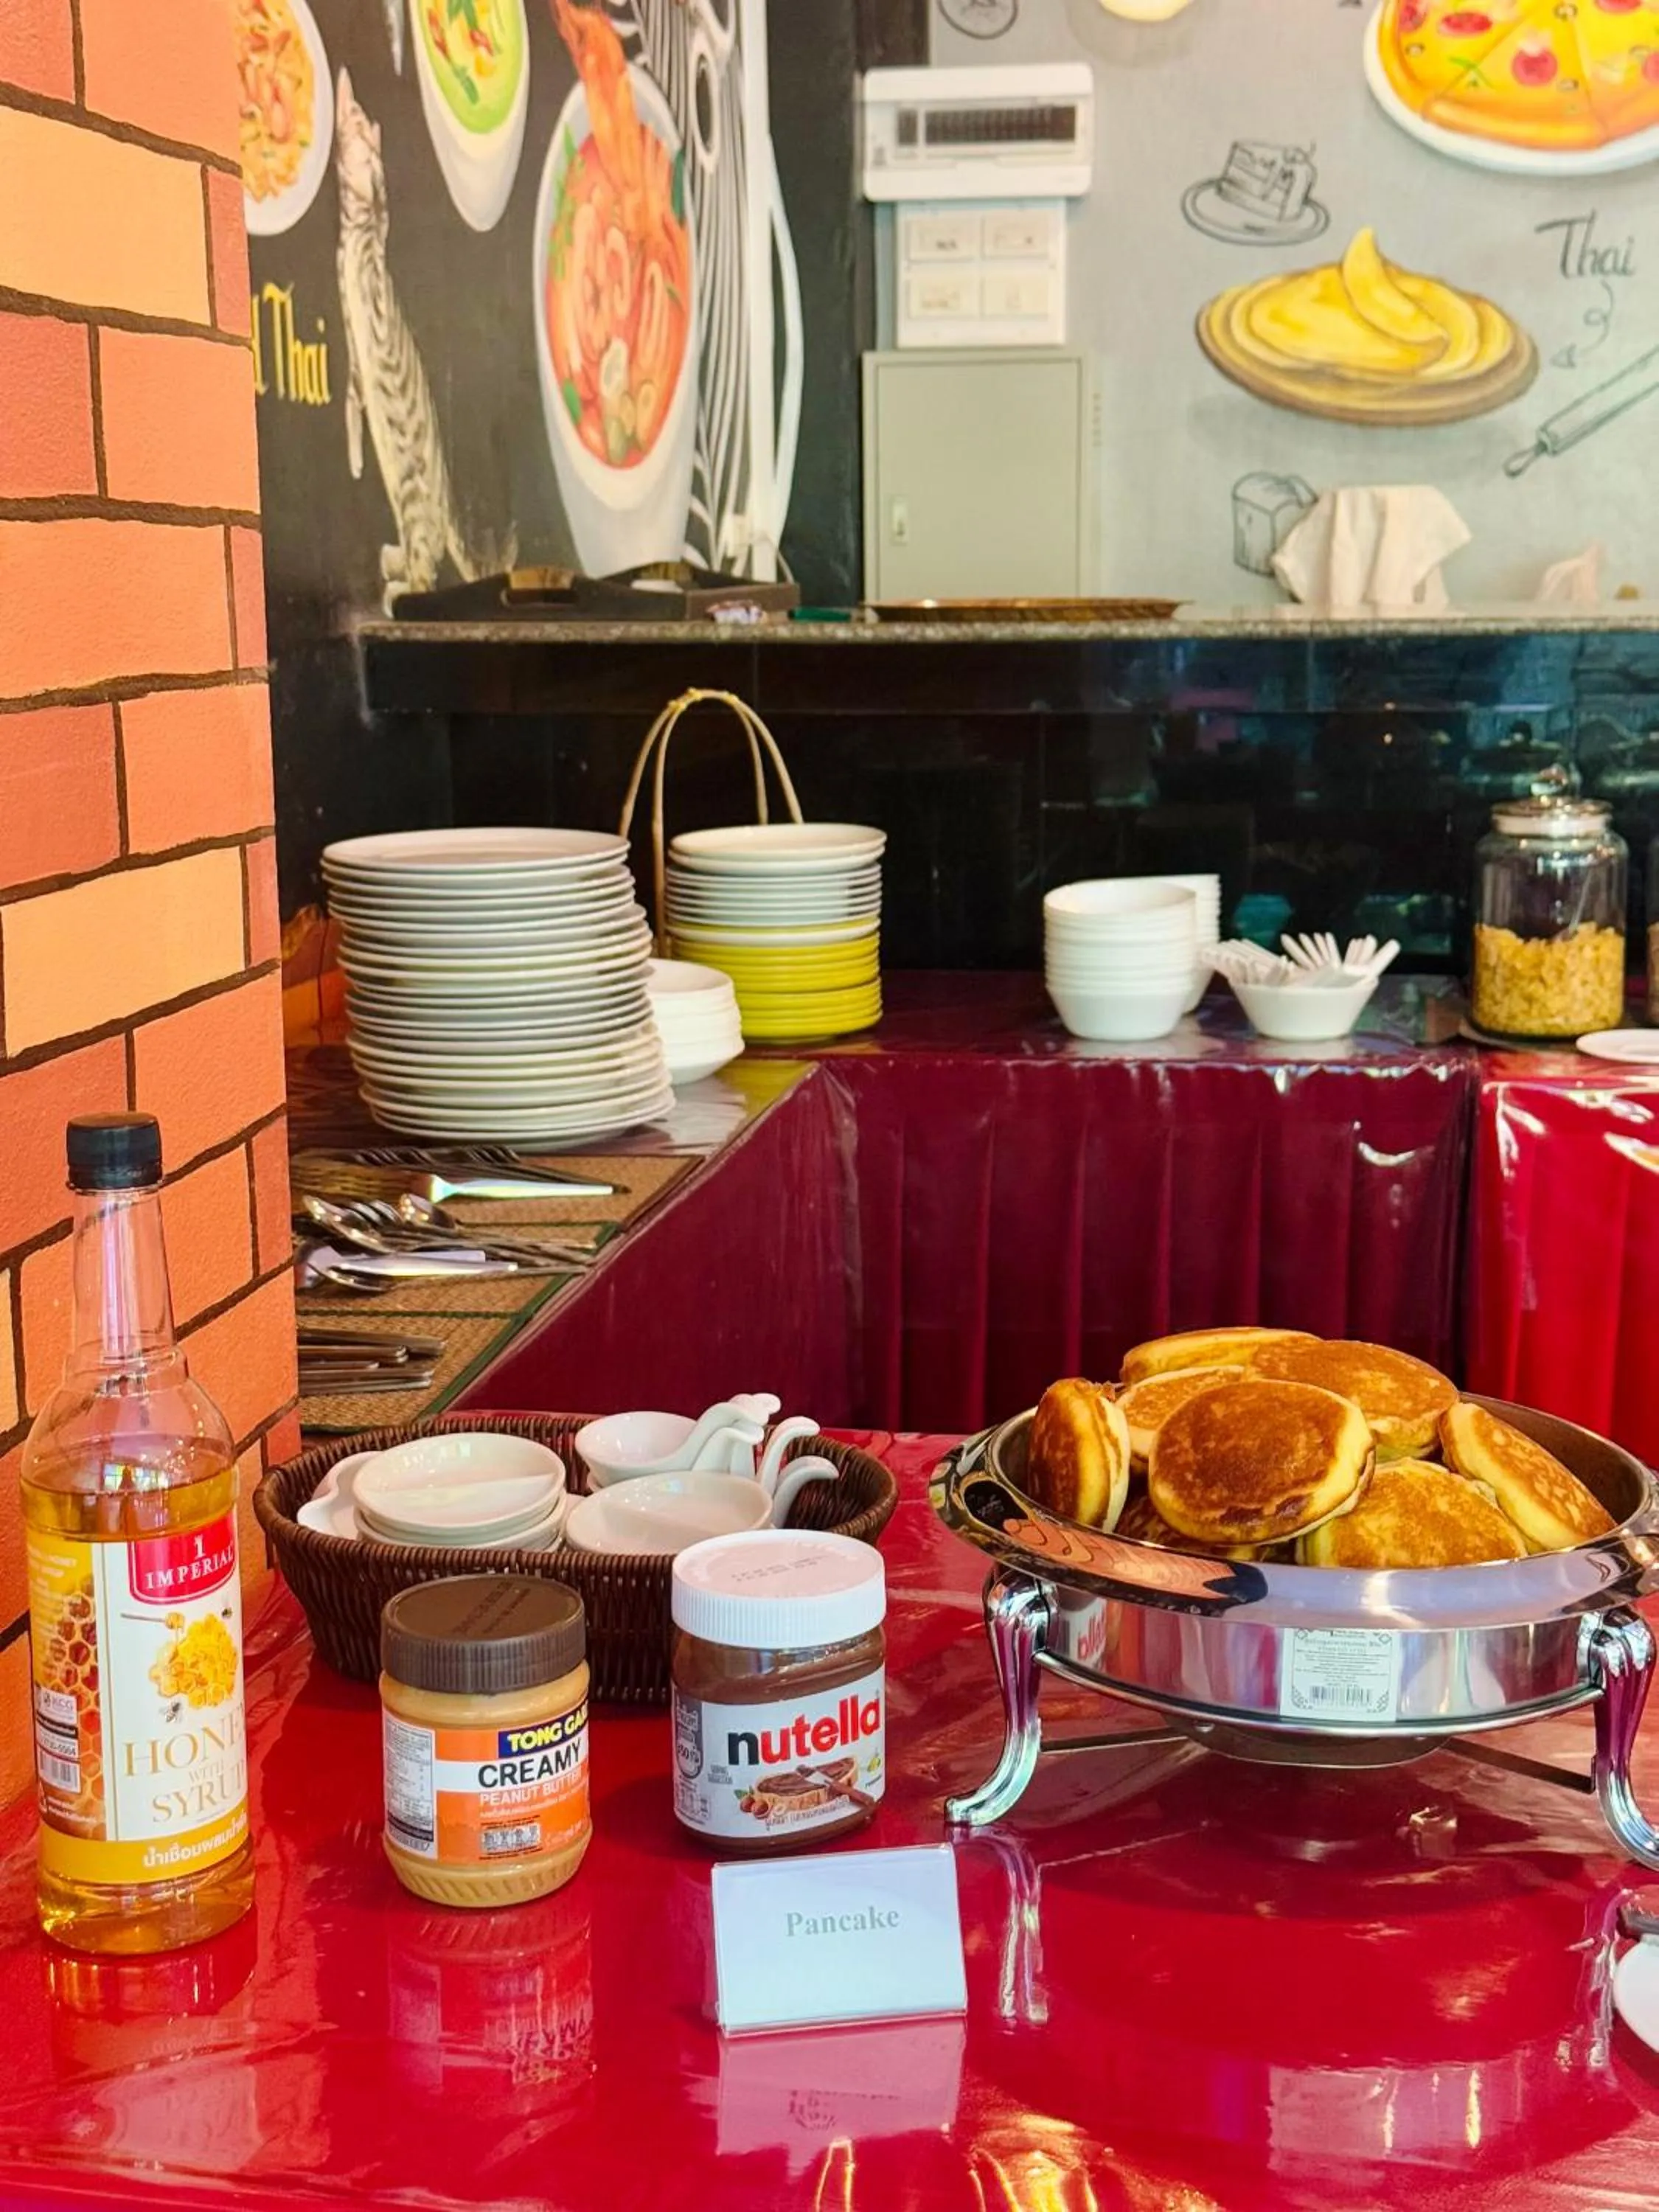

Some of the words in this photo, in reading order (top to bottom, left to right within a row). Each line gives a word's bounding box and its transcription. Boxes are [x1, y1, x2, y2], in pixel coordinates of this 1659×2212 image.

[1534, 206, 1636, 279] Thai
[262, 282, 331, 406] Thai
[145, 1541, 234, 1590] IMPERIAL
[507, 1722, 563, 1753] TONG
[728, 1694, 881, 1765] nutella
[478, 1737, 580, 1788] CREAMY
[479, 1786, 540, 1806] PEANUT
[786, 1905, 900, 1937] Pancake
